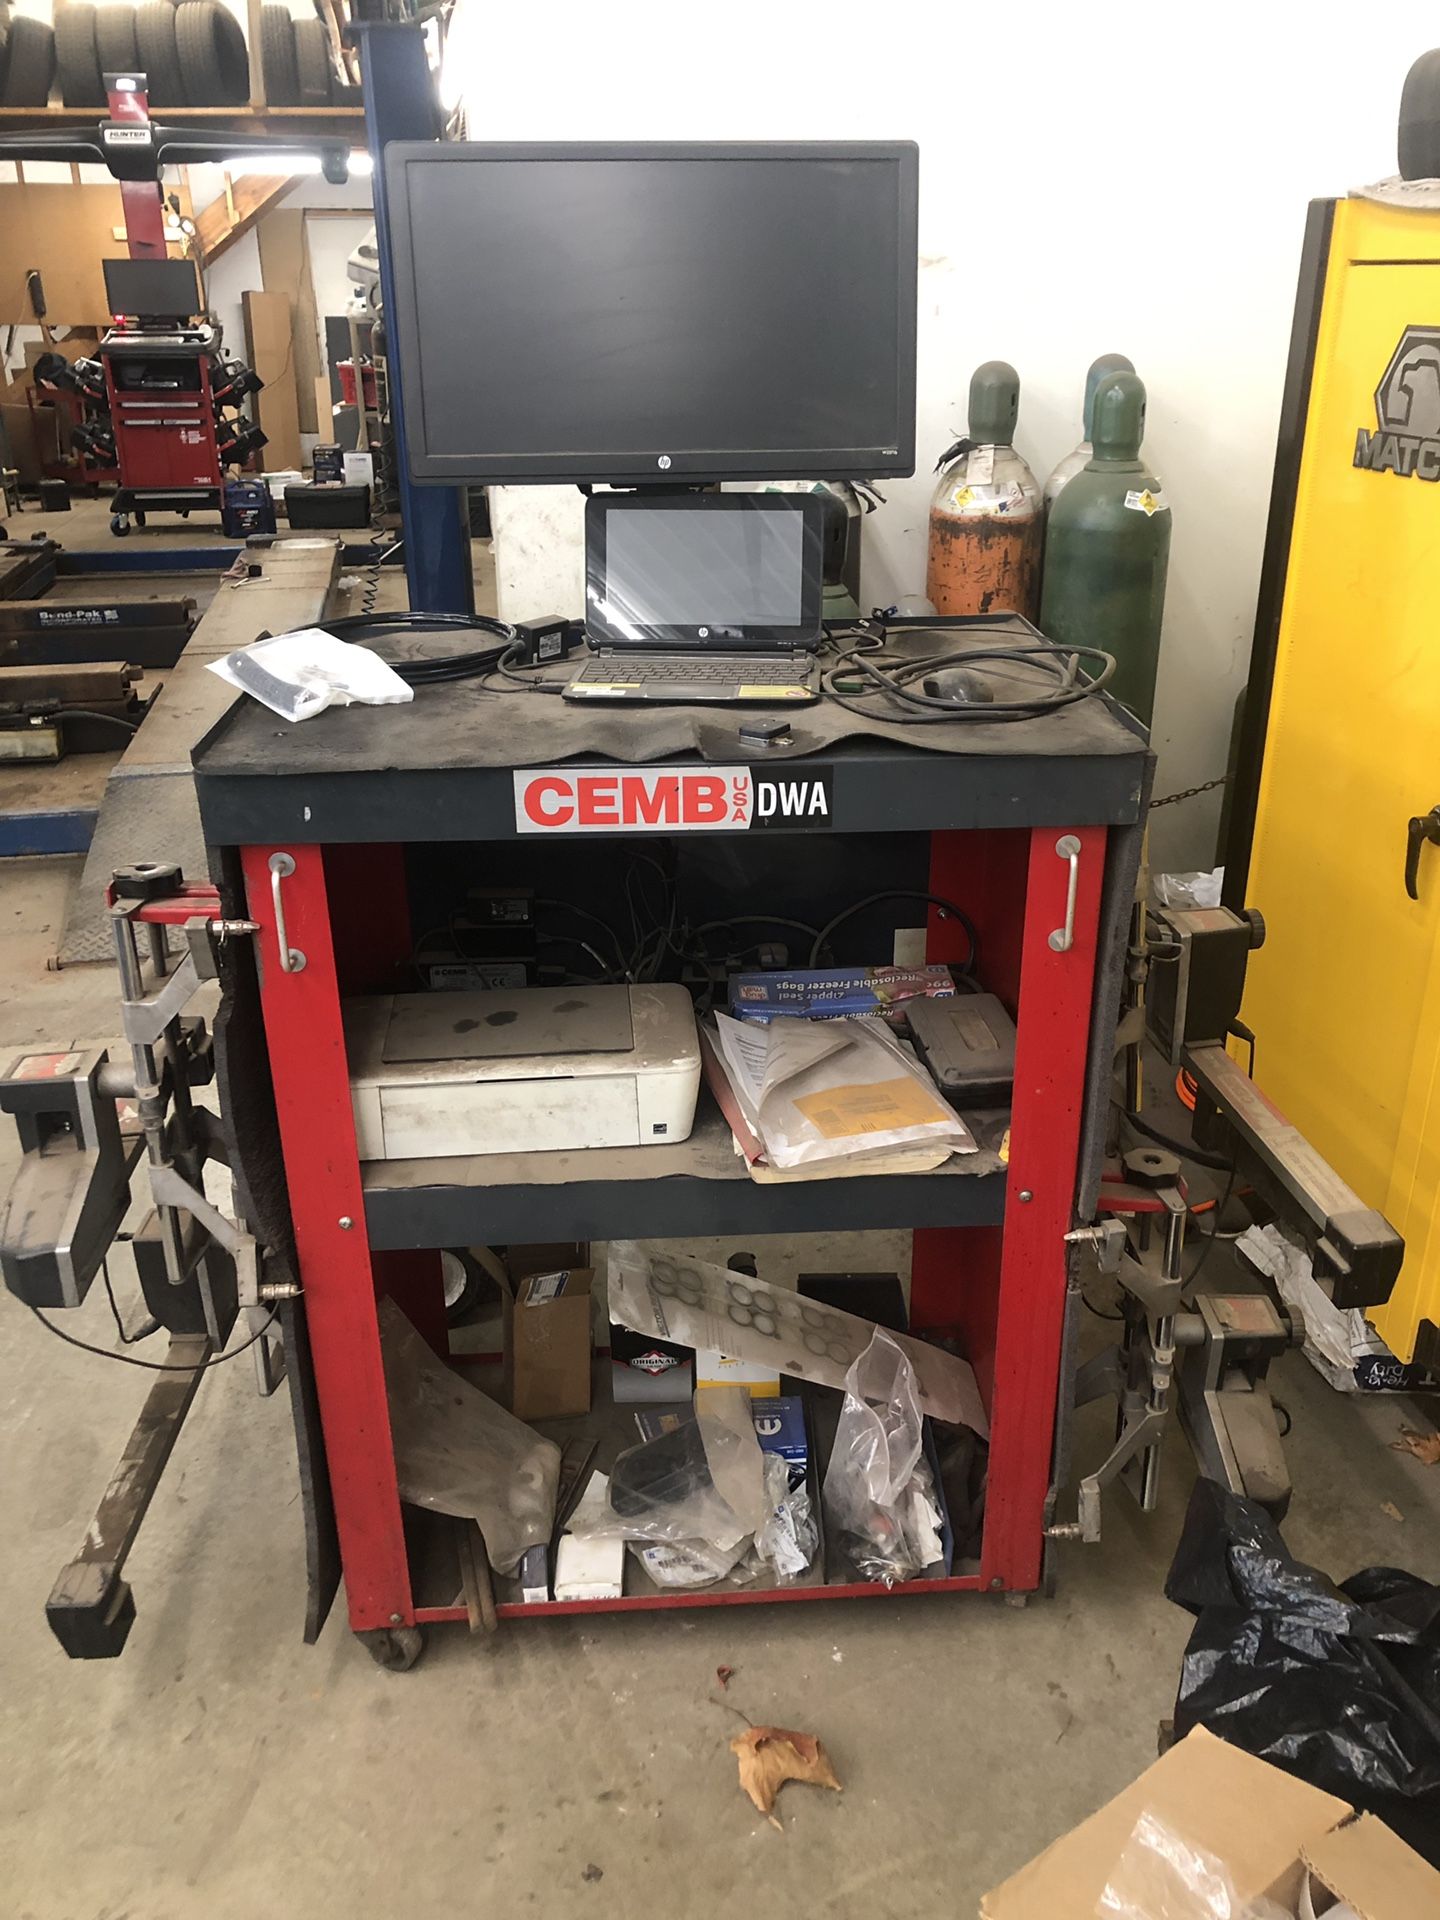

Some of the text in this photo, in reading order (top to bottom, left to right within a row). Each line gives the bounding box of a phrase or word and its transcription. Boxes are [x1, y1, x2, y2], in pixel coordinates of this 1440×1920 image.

[524, 775, 729, 827] CEMB
[758, 781, 828, 817] DWA
[776, 981, 805, 991] Bags
[807, 980, 851, 990] Freezer
[779, 990, 845, 1001] Zipper Seal
[633, 1358, 675, 1366] ORIGINAL
